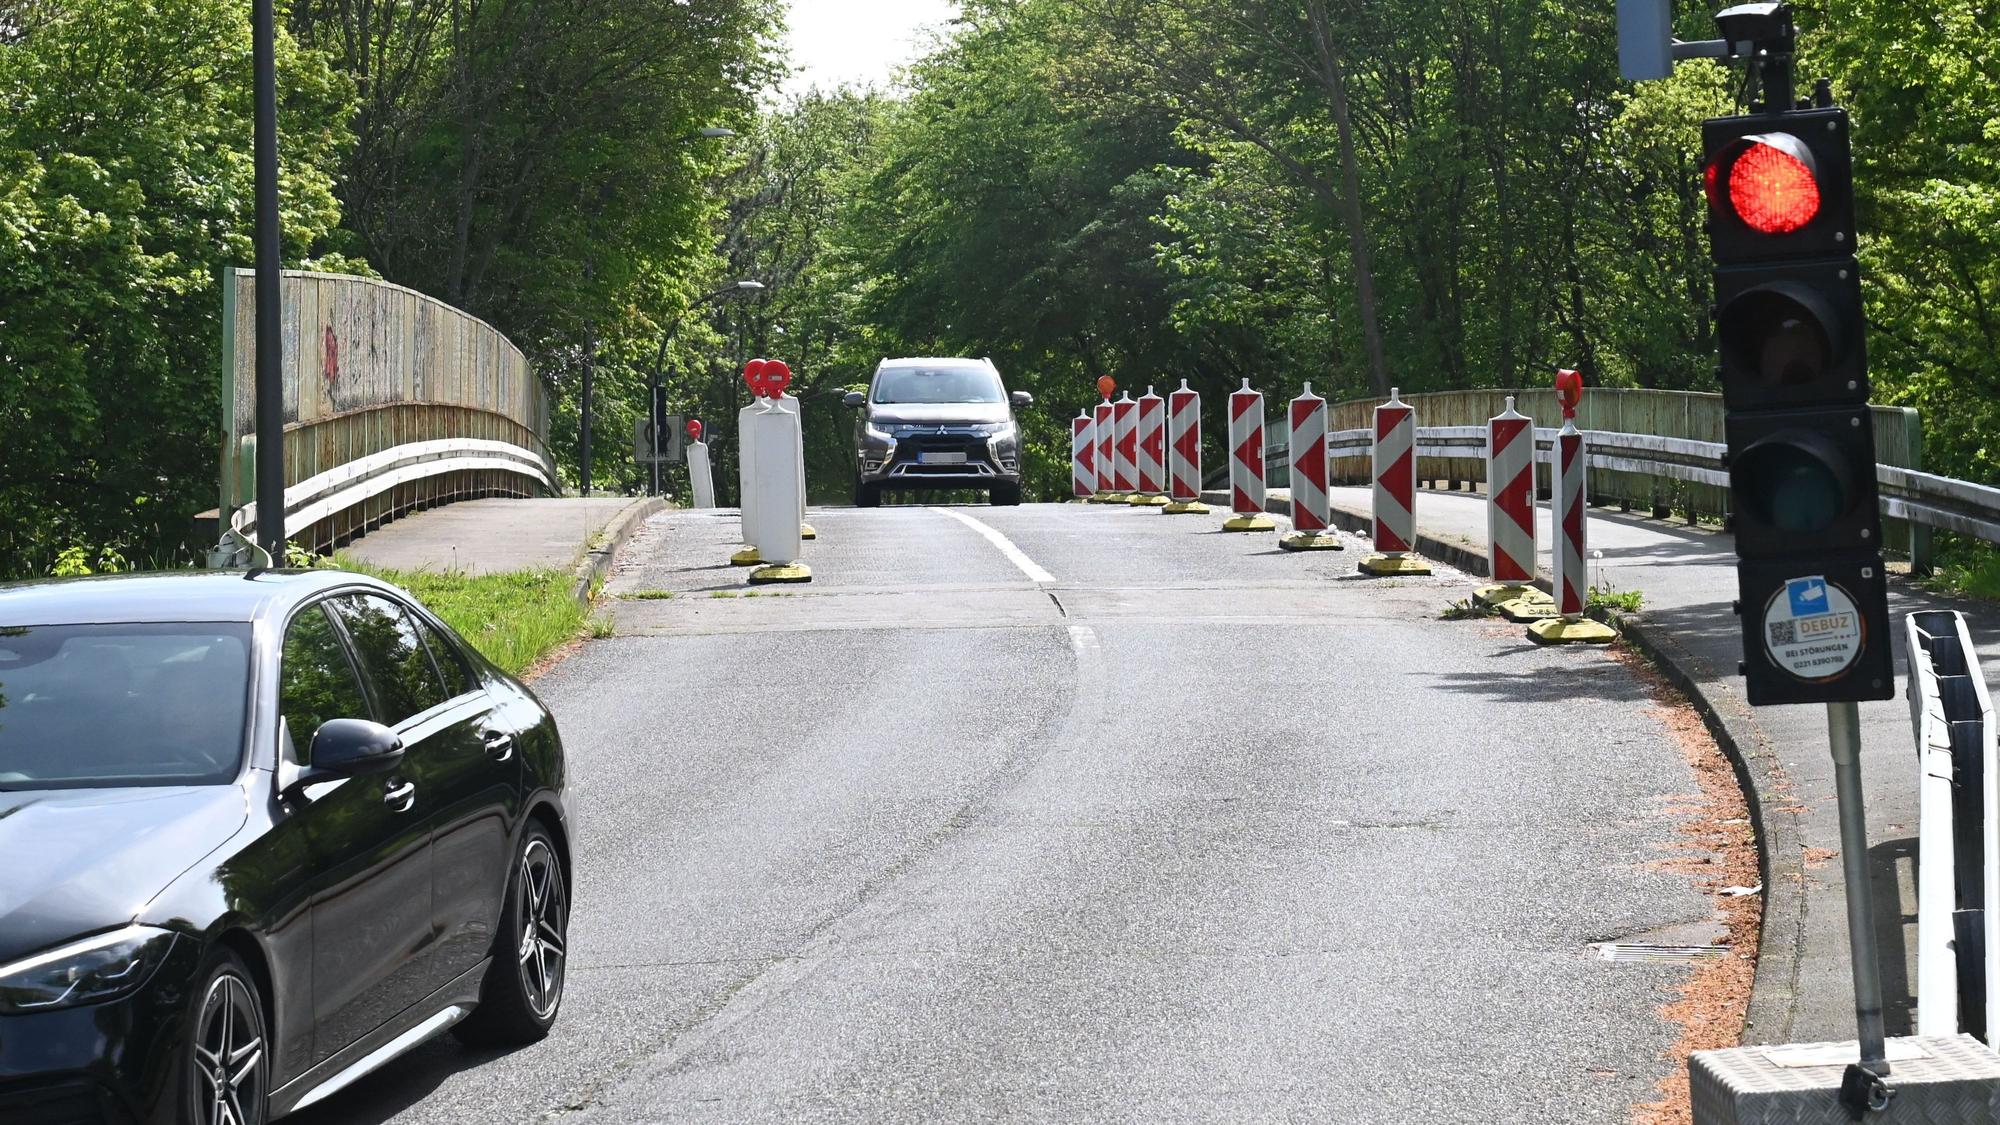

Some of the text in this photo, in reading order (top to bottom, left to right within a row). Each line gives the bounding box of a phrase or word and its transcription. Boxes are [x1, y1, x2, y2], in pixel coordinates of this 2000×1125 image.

[1800, 616, 1849, 633] DEBUZ
[1785, 643, 1849, 658] BEI STÖRUNGEN
